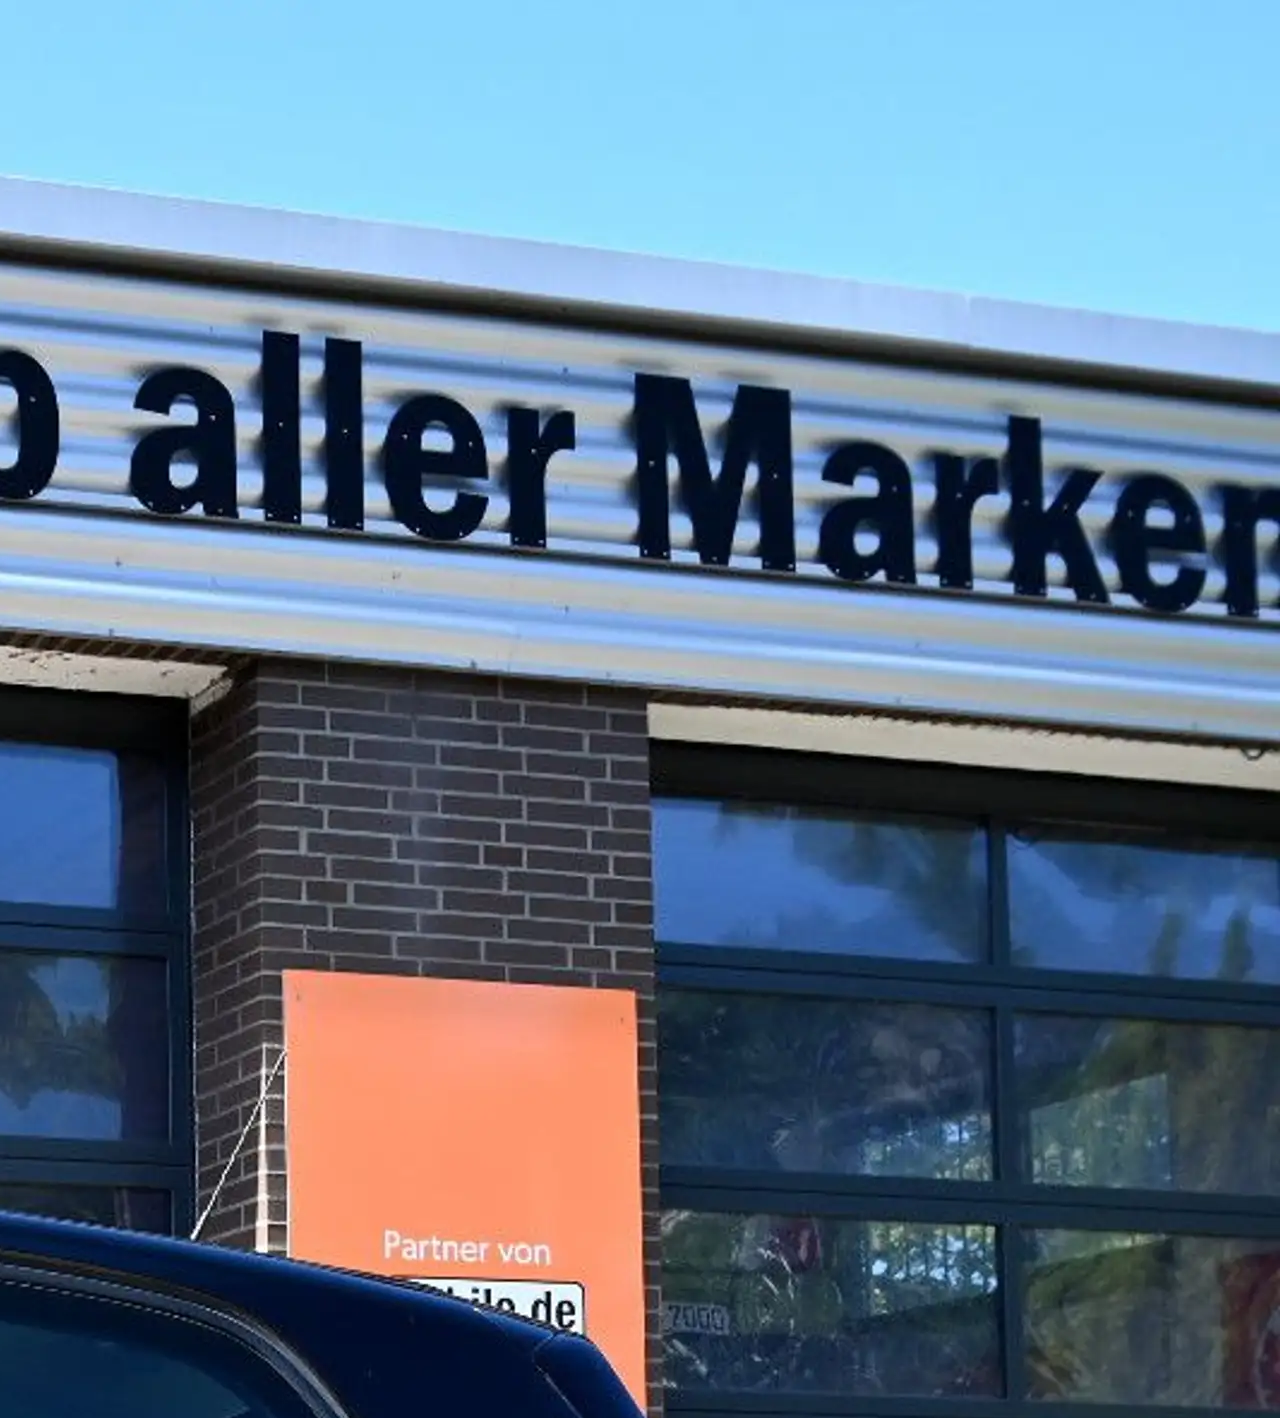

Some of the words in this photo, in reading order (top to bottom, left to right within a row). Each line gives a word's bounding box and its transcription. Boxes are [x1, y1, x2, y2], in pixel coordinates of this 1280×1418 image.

[128, 328, 576, 548] aller
[383, 1229, 489, 1263] Partner
[498, 1242, 552, 1266] von
